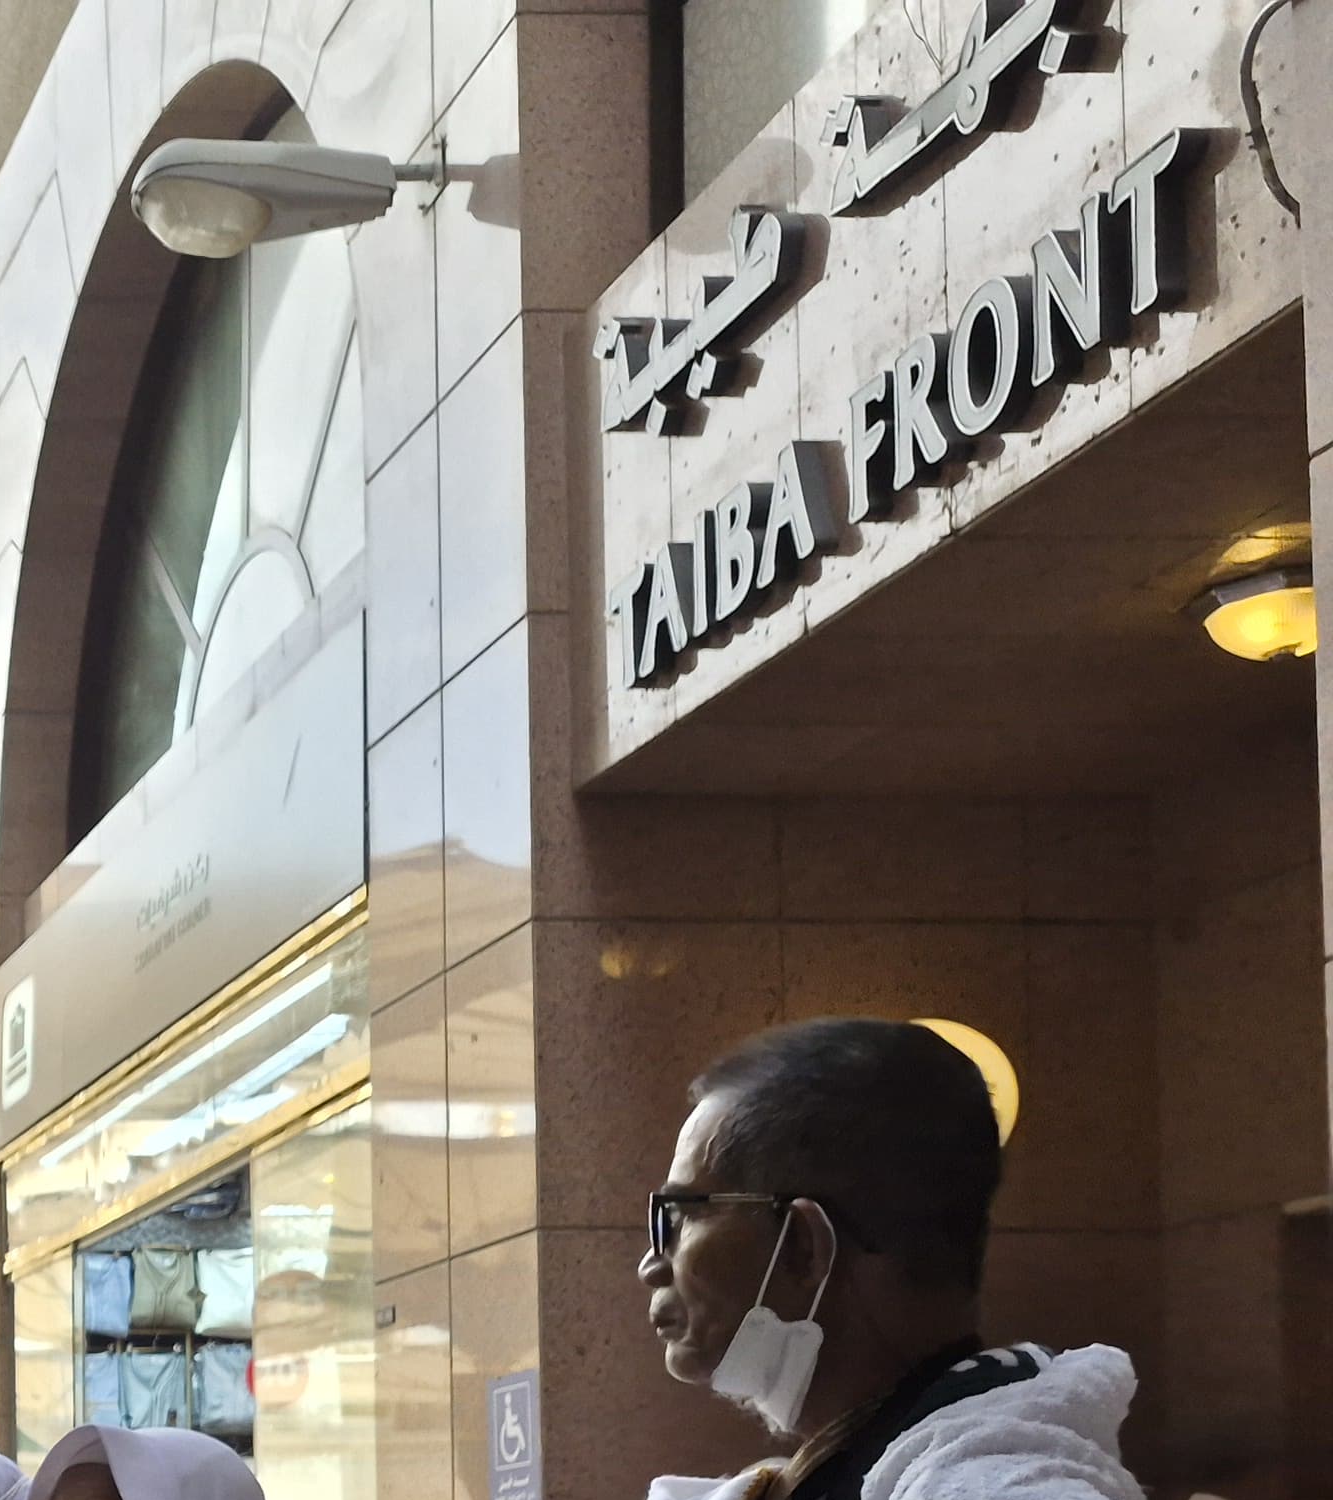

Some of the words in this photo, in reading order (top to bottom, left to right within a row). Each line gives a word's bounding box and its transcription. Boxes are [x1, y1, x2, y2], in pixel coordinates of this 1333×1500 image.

[593, 207, 783, 433] طيبة
[605, 438, 815, 690] TAIBA
[848, 127, 1181, 525] FRONT
